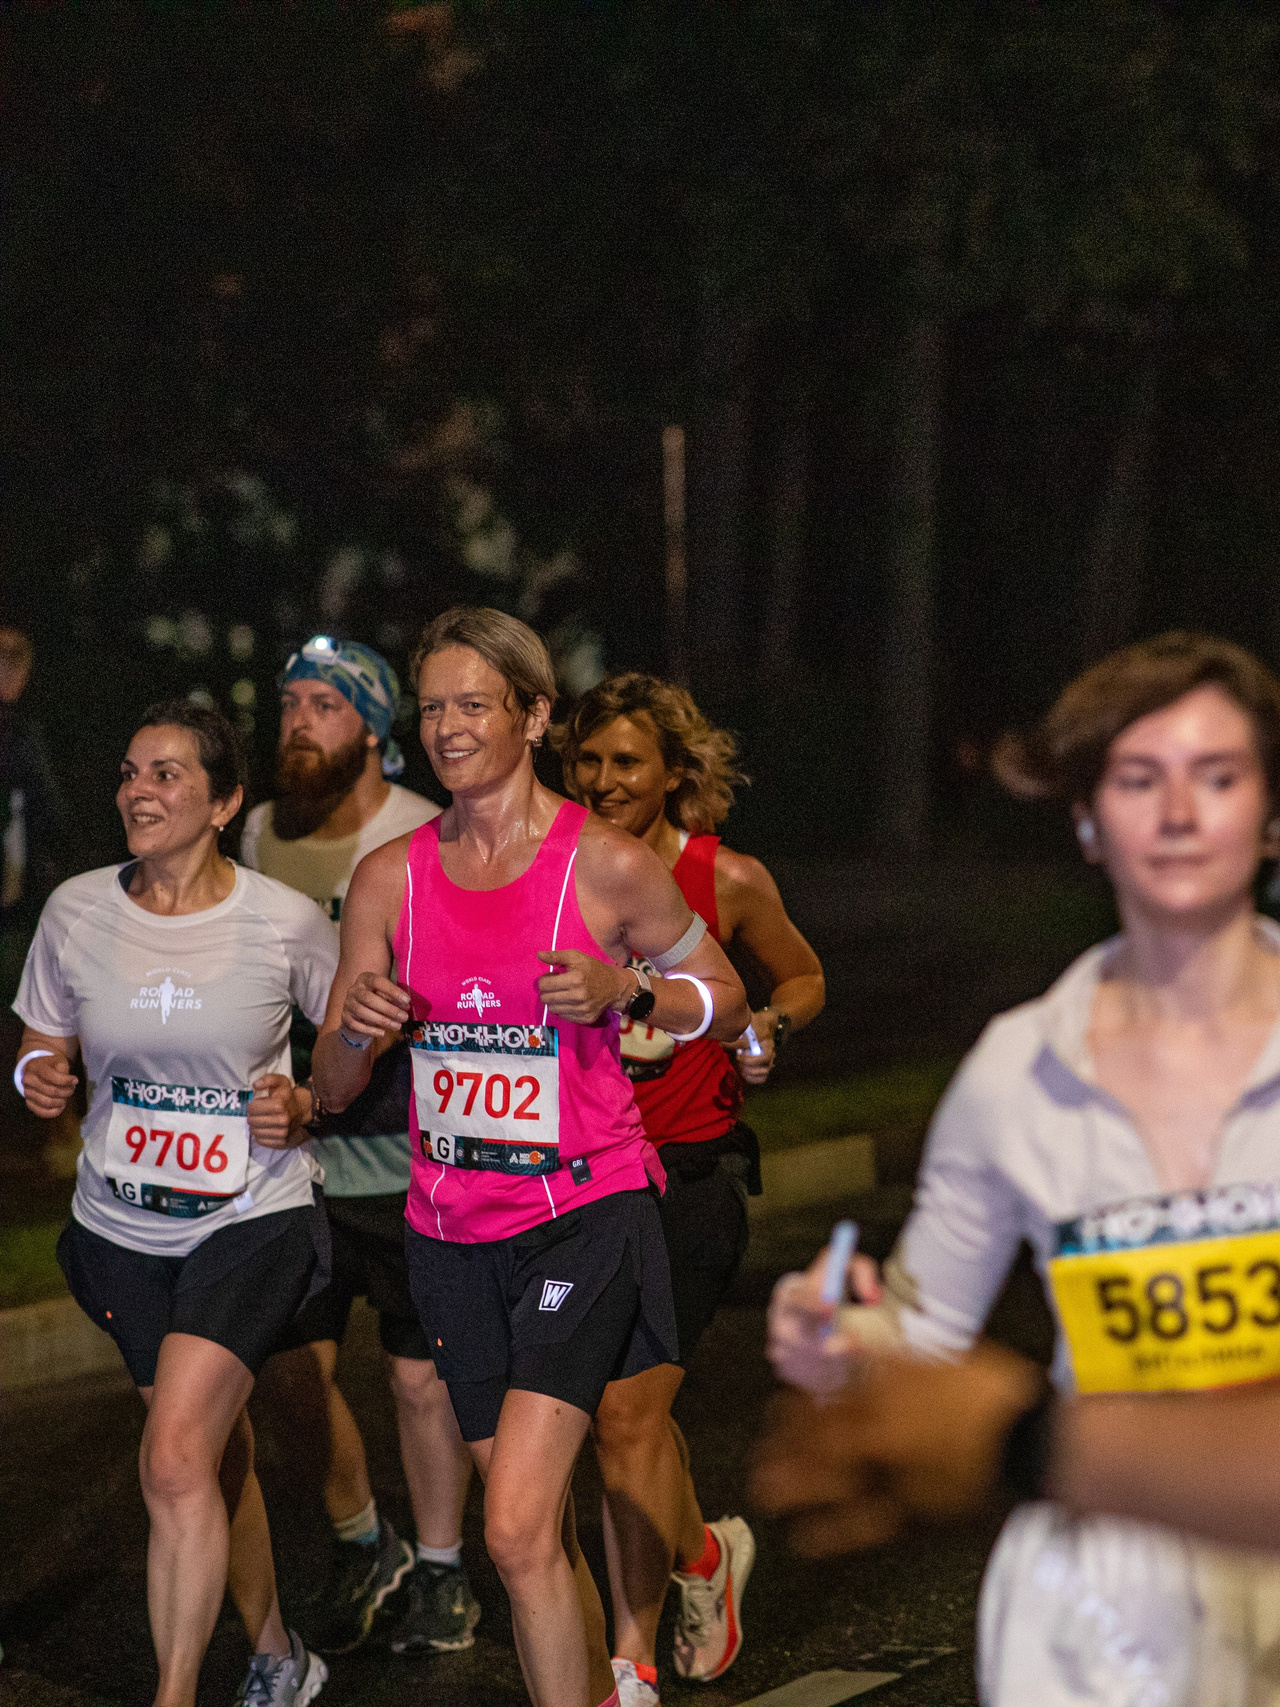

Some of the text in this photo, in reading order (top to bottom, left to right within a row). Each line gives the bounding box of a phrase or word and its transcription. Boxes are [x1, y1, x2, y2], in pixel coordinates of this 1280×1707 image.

[461, 976, 492, 986] WORLD CLASS
[139, 986, 195, 998] ROAD
[460, 991, 495, 1001] ROAD
[130, 998, 202, 1009] RUNNERS
[456, 999, 501, 1009] RUNNERS
[433, 1069, 541, 1121] 9702
[125, 1125, 229, 1174] 9706
[437, 1136, 450, 1159] G
[121, 1182, 137, 1201] G
